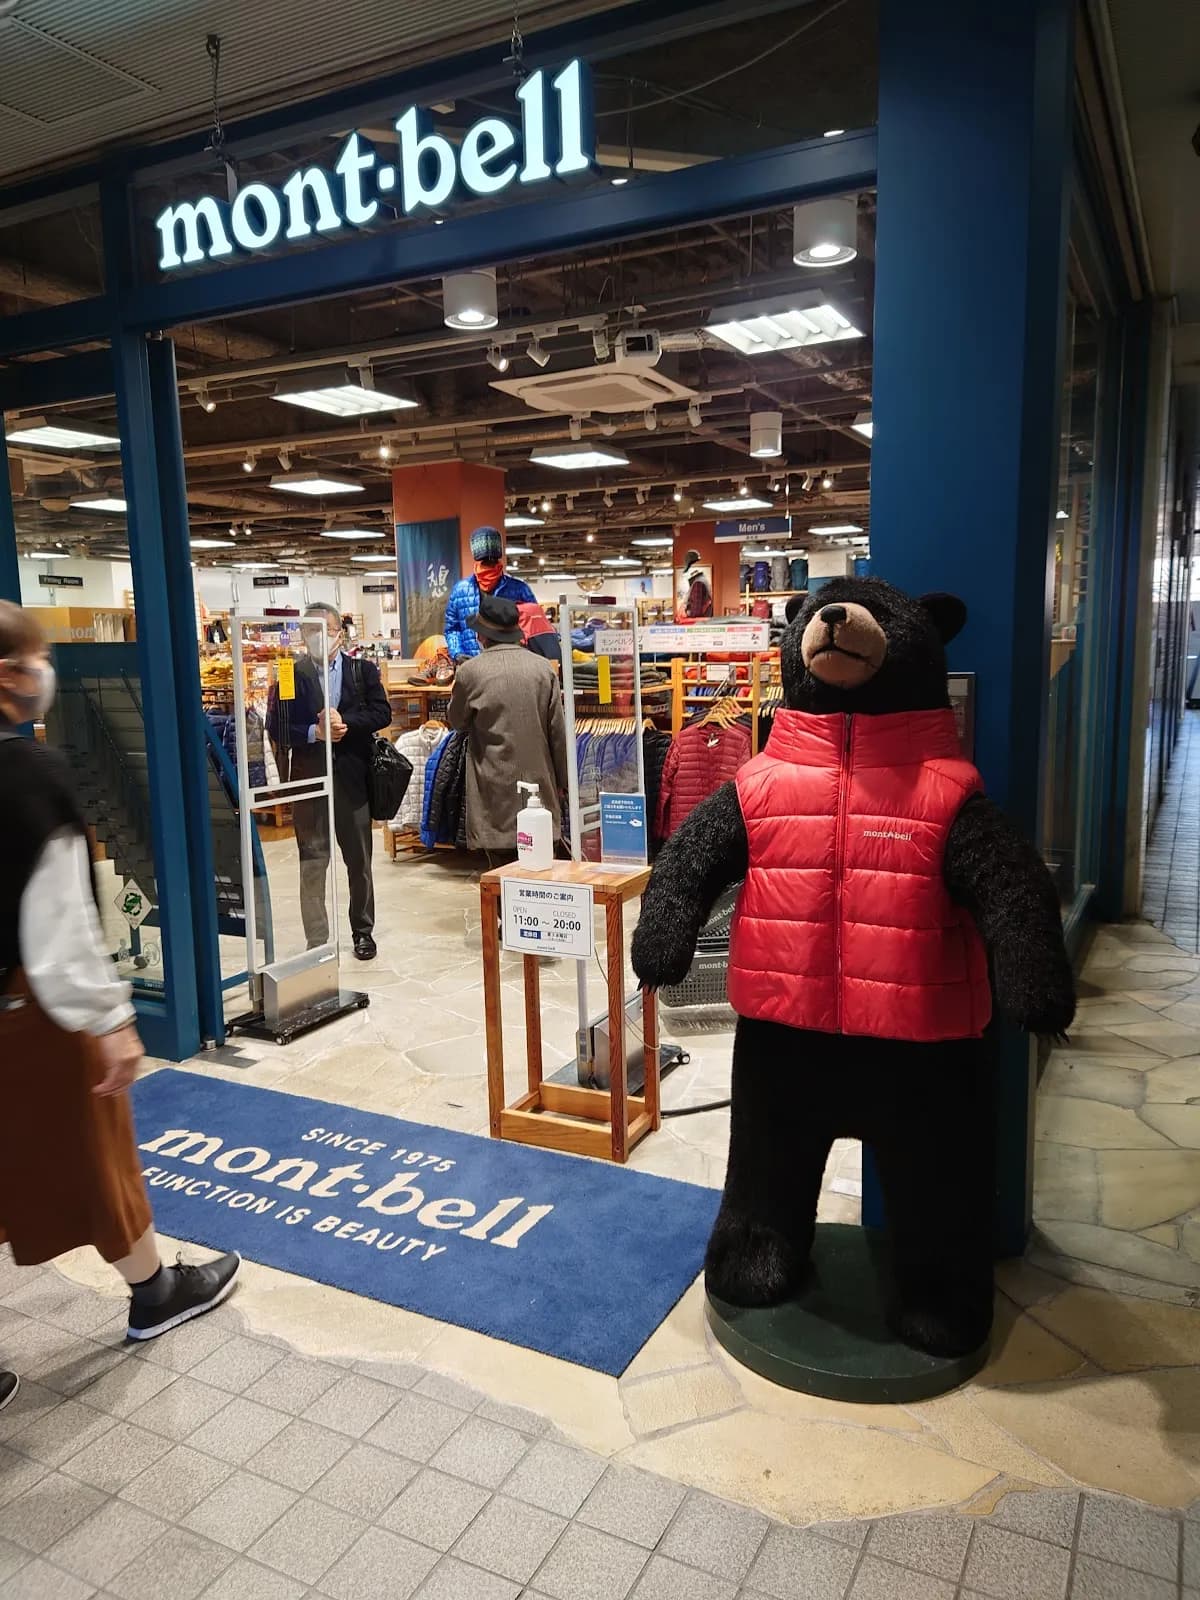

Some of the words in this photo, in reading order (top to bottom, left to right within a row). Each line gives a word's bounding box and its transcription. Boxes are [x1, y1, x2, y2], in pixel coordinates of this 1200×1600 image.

[738, 523, 766, 533] Men's
[519, 889, 574, 902] 営業時間のご案内
[512, 906, 528, 914] OPEN
[552, 910, 576, 919] CLOSED
[513, 914, 539, 927] 11:00
[553, 919, 581, 931] 20:00
[301, 1127, 387, 1156] SINCE
[395, 1148, 457, 1173] 1975
[140, 1166, 278, 1215] FUNCTION
[275, 1205, 312, 1225] IS
[312, 1215, 448, 1262] BEAUTY
